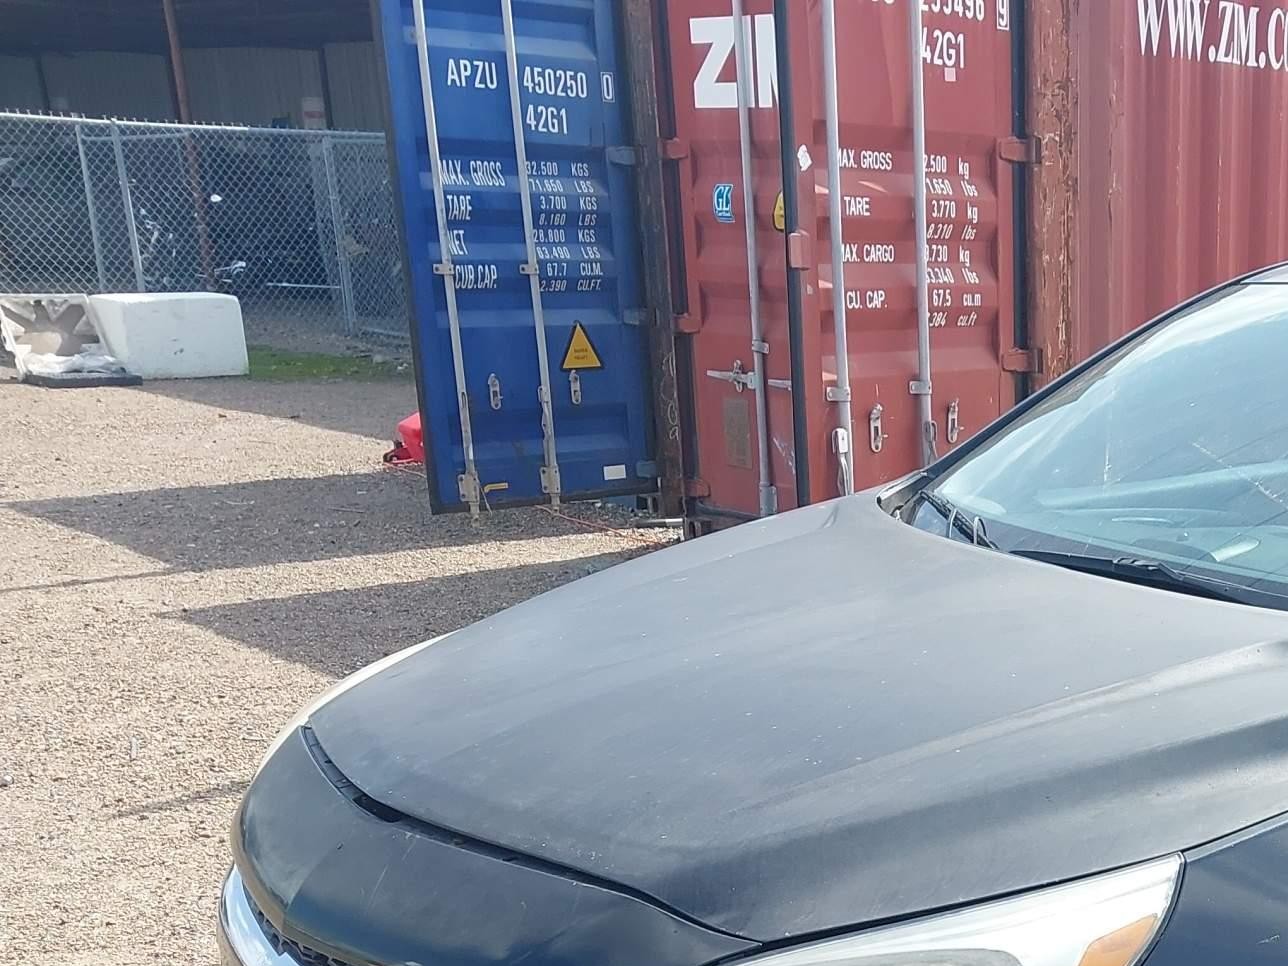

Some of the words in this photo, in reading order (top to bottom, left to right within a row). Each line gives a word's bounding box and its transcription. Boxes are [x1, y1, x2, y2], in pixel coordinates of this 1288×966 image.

[922, 27, 965, 69] 42G1
[447, 58, 498, 89] APZU
[523, 66, 588, 99] 450250
[602, 73, 613, 100] 0
[526, 104, 568, 135] 42G1
[526, 161, 559, 176] 32.500
[571, 162, 589, 177] KGS
[860, 150, 893, 171] GROSS
[958, 156, 970, 180] kg
[438, 159, 470, 186] MAX.
[470, 160, 505, 187] GROSS
[528, 178, 564, 193] 71.650
[574, 180, 595, 193] LBS
[960, 180, 979, 197] lbs
[447, 195, 473, 221] TARE
[540, 195, 567, 210] 3.700
[579, 196, 598, 210] KGS
[715, 186, 730, 210] GL
[843, 196, 871, 217] TARE
[578, 213, 597, 226] LBS
[932, 201, 956, 219] 3.770
[967, 202, 978, 223] kg
[577, 228, 596, 243] KGS
[961, 224, 977, 240] lbs
[448, 230, 468, 256] NET
[581, 246, 600, 259] LBS
[863, 244, 895, 263] CARGO
[959, 245, 970, 267] kg
[546, 262, 567, 277] 67.7
[962, 267, 980, 284] lbs
[846, 291, 863, 309] CU.
[866, 289, 888, 309] CAP.
[933, 288, 952, 307] 67.5
[963, 293, 982, 307] cu.m
